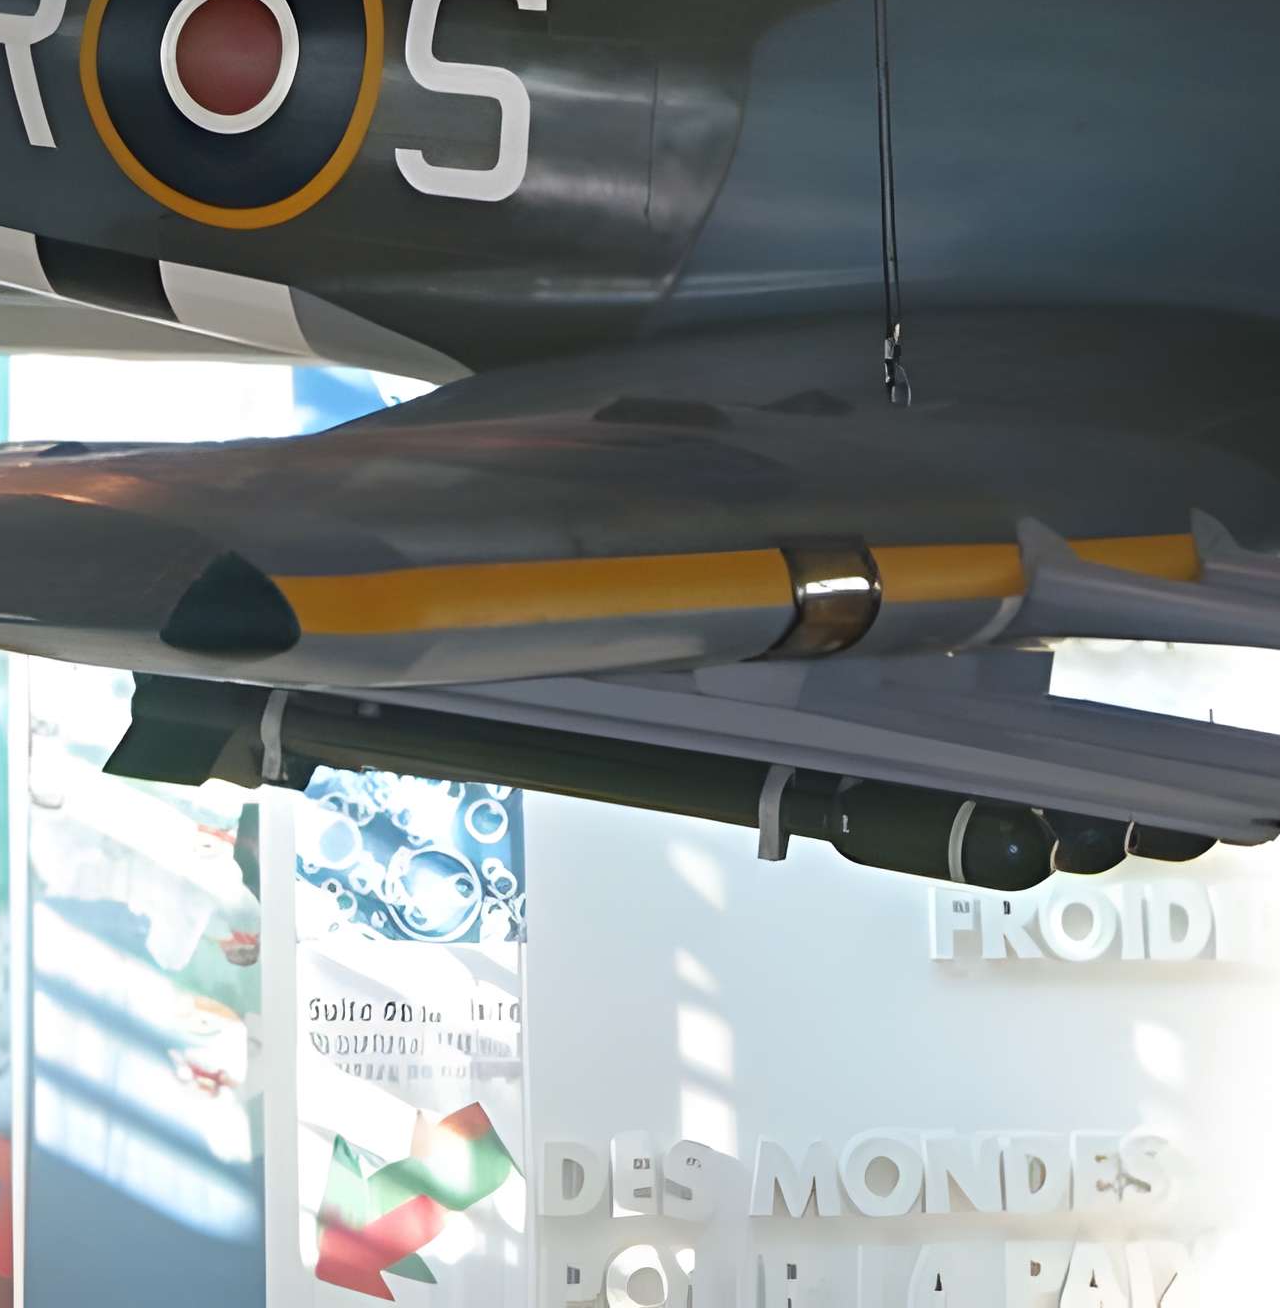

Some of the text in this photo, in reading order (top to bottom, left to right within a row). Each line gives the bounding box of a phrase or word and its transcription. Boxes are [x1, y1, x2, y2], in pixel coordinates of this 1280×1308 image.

[928, 879, 1265, 961] FROID
[537, 1126, 1186, 1220] DES MONDES
